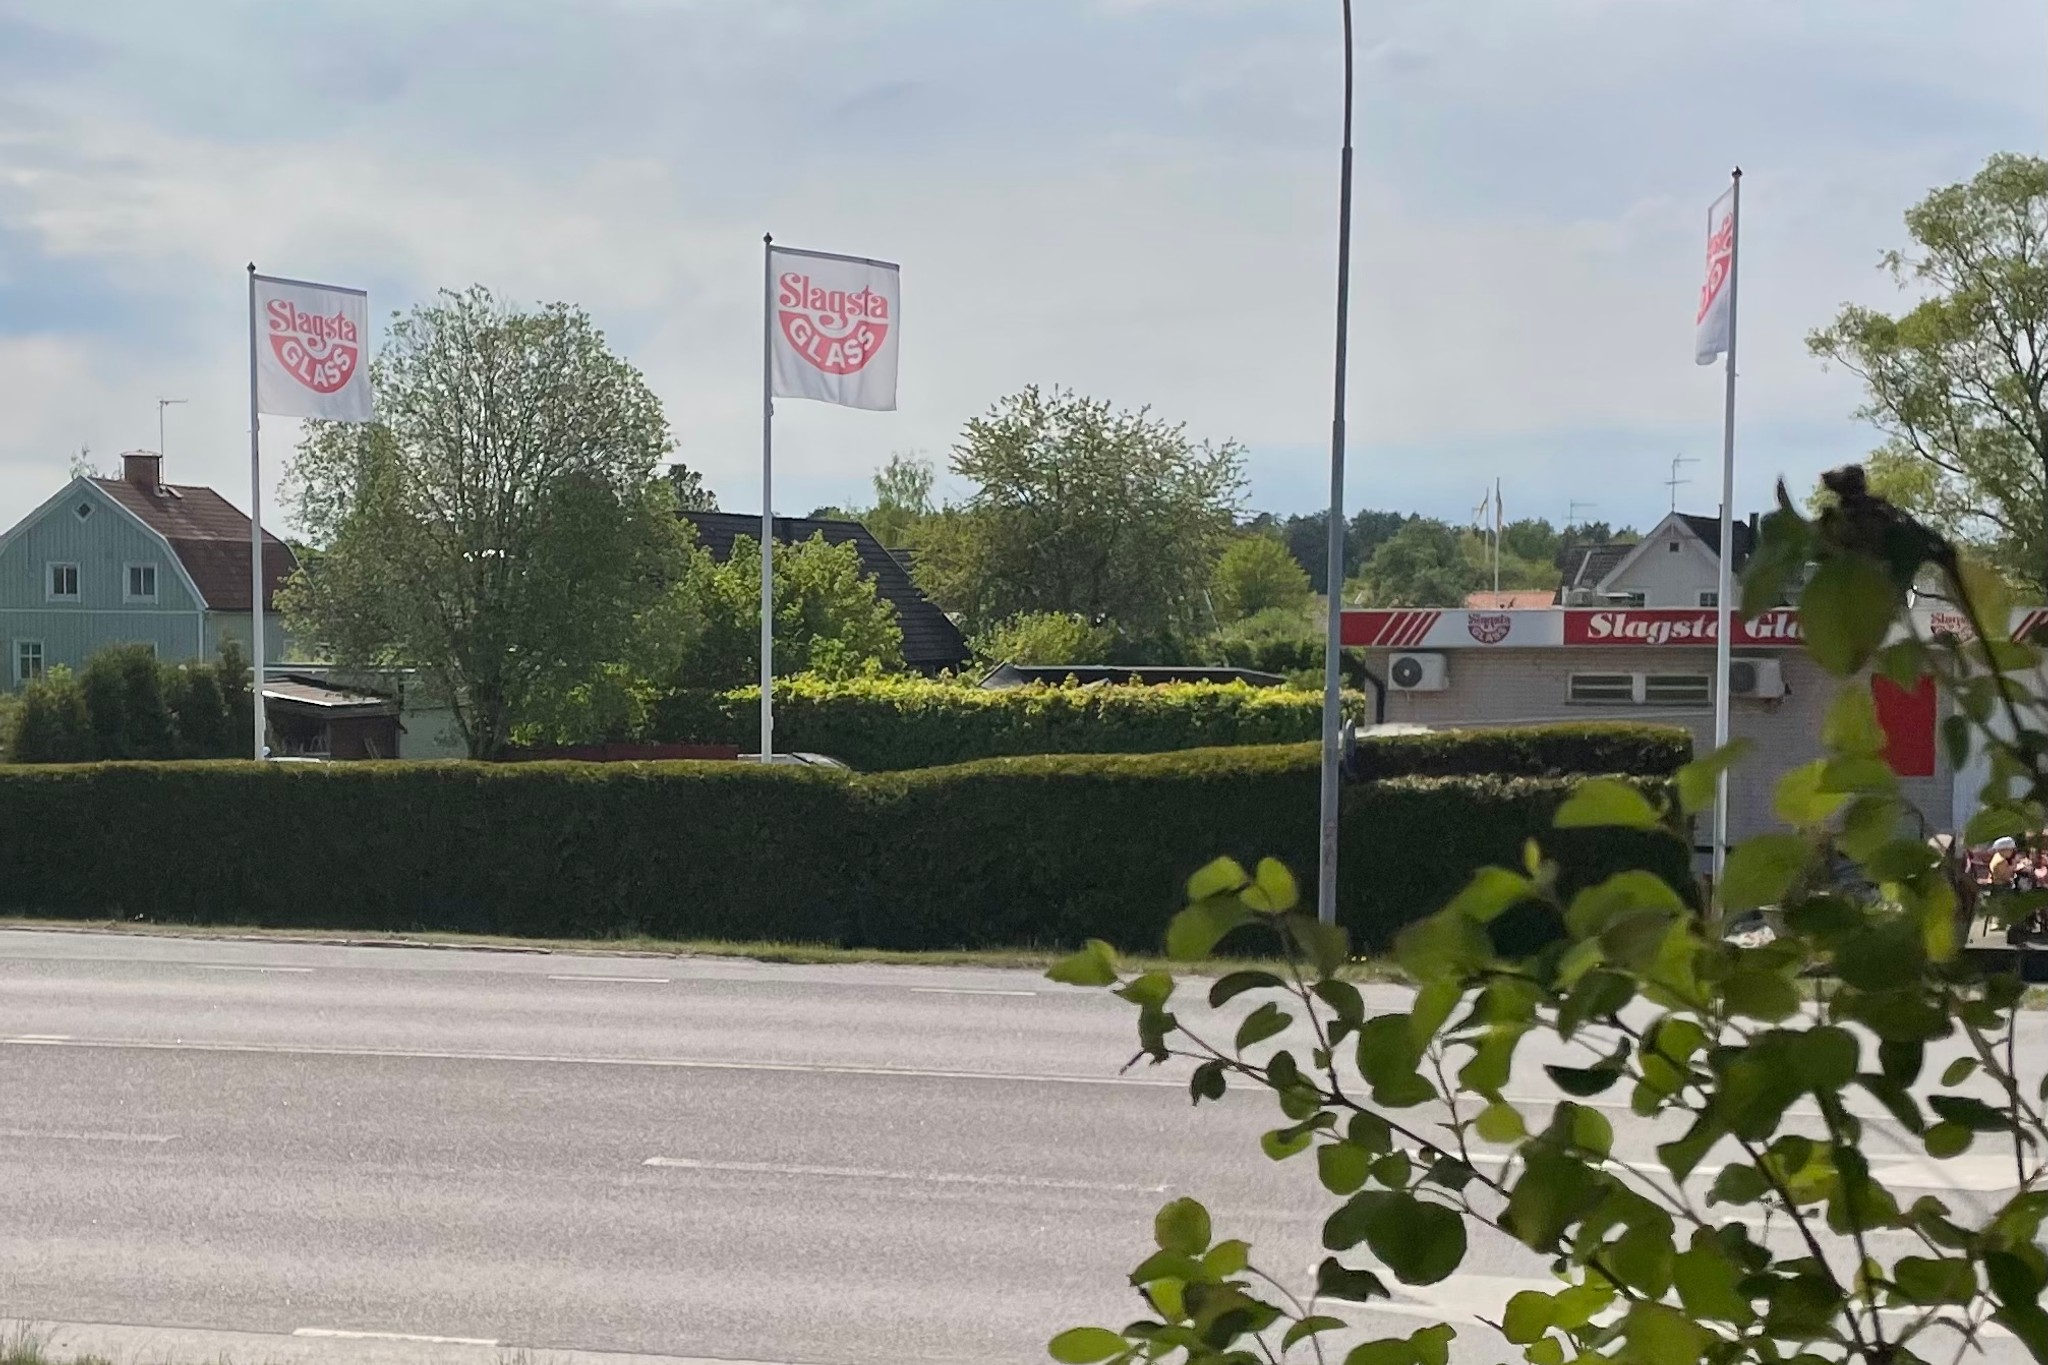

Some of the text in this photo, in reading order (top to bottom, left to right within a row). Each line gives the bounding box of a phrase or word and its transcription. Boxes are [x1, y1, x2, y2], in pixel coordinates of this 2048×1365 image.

[266, 298, 358, 352] Slagsta
[778, 271, 889, 330] Slagsta
[281, 340, 351, 388] GLASS
[789, 317, 875, 369] GLASS
